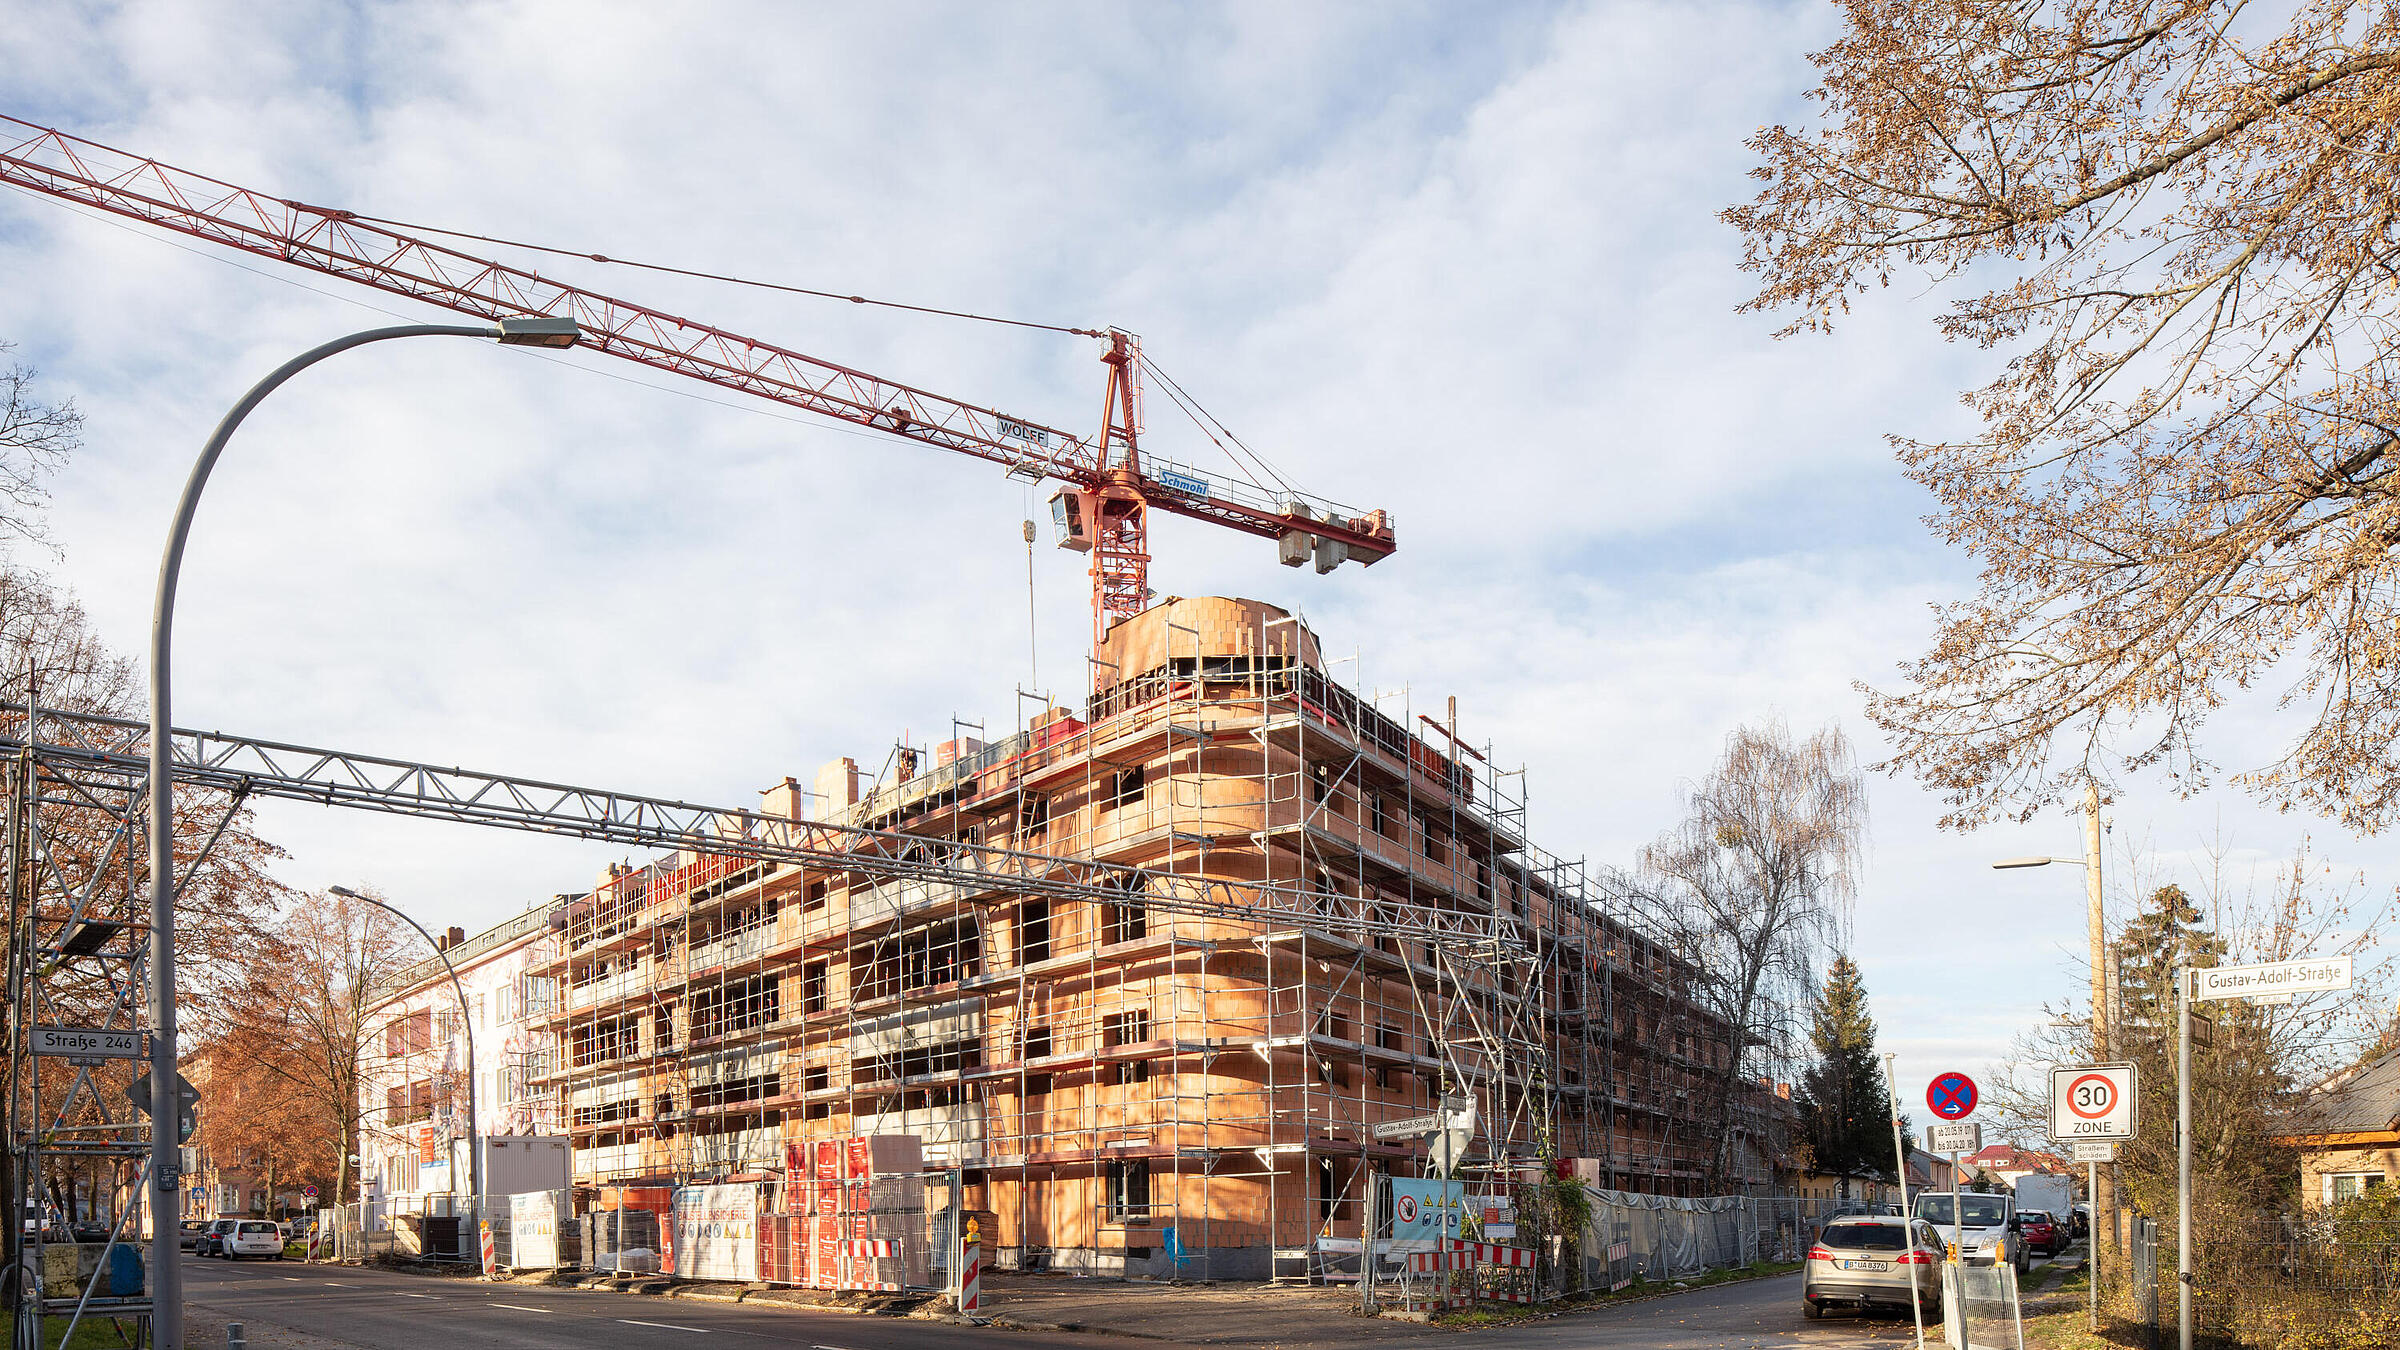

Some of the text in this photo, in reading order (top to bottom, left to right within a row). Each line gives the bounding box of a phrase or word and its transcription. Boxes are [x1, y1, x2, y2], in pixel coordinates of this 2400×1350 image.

[1000, 421, 1045, 442] WOLFF
[1160, 471, 1208, 495] Schmohl
[2208, 964, 2341, 988] Gustav-Adolf-Straße
[45, 1033, 132, 1051] Straße 246
[2078, 1086, 2107, 1107] 30
[1377, 1118, 1433, 1133] Gustav-Adolf-Straße
[2073, 1121, 2112, 1133] ZONE
